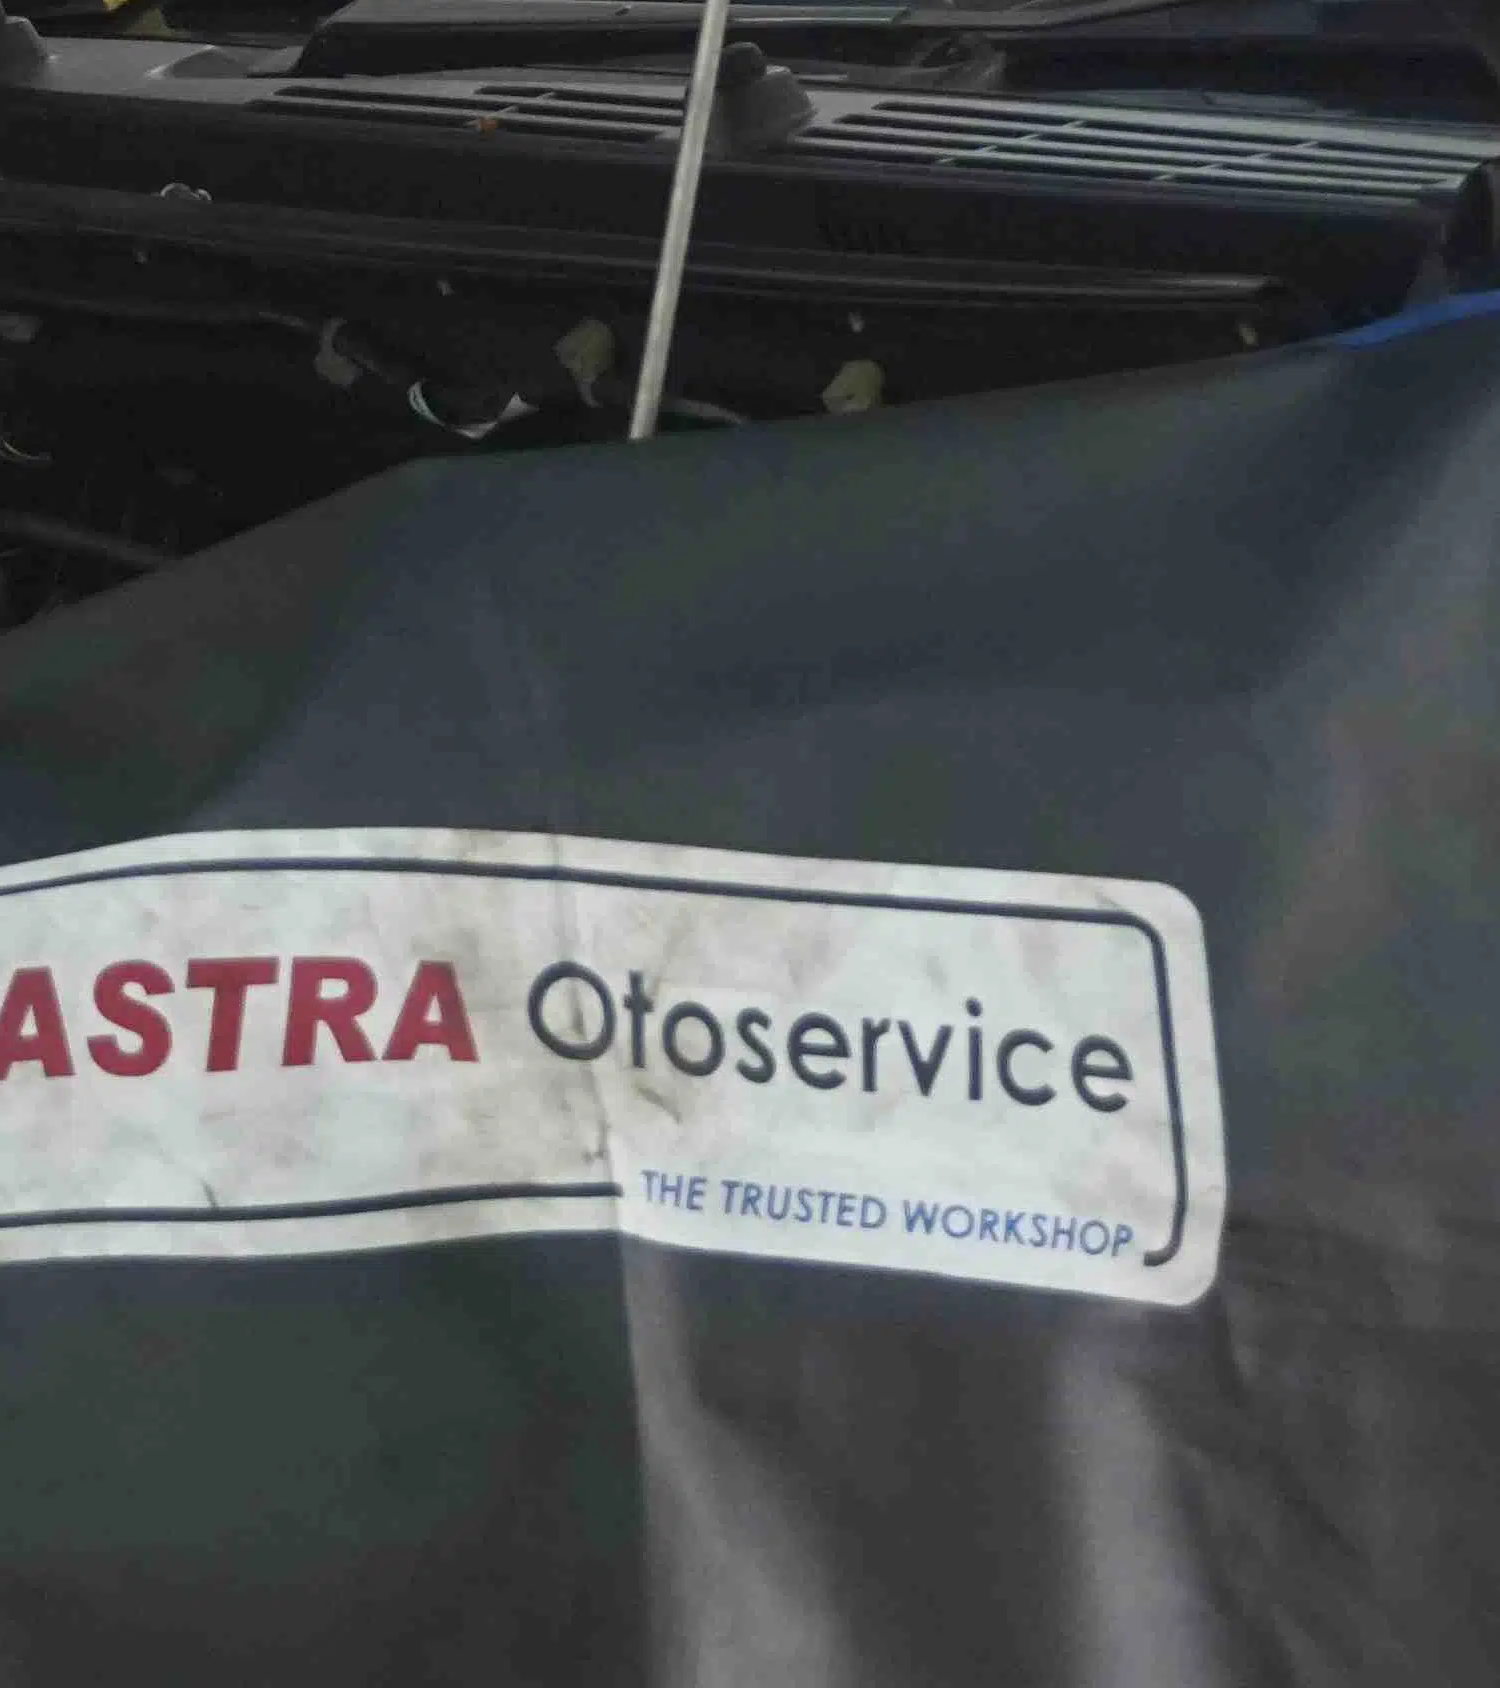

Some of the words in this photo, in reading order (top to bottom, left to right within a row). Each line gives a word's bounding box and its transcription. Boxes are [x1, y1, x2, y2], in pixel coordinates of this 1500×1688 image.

[527, 959, 1134, 1114] Otoservice
[640, 1168, 709, 1213] THE
[720, 1178, 888, 1231] TRUSTED
[901, 1198, 1134, 1259] WORKSHOP
